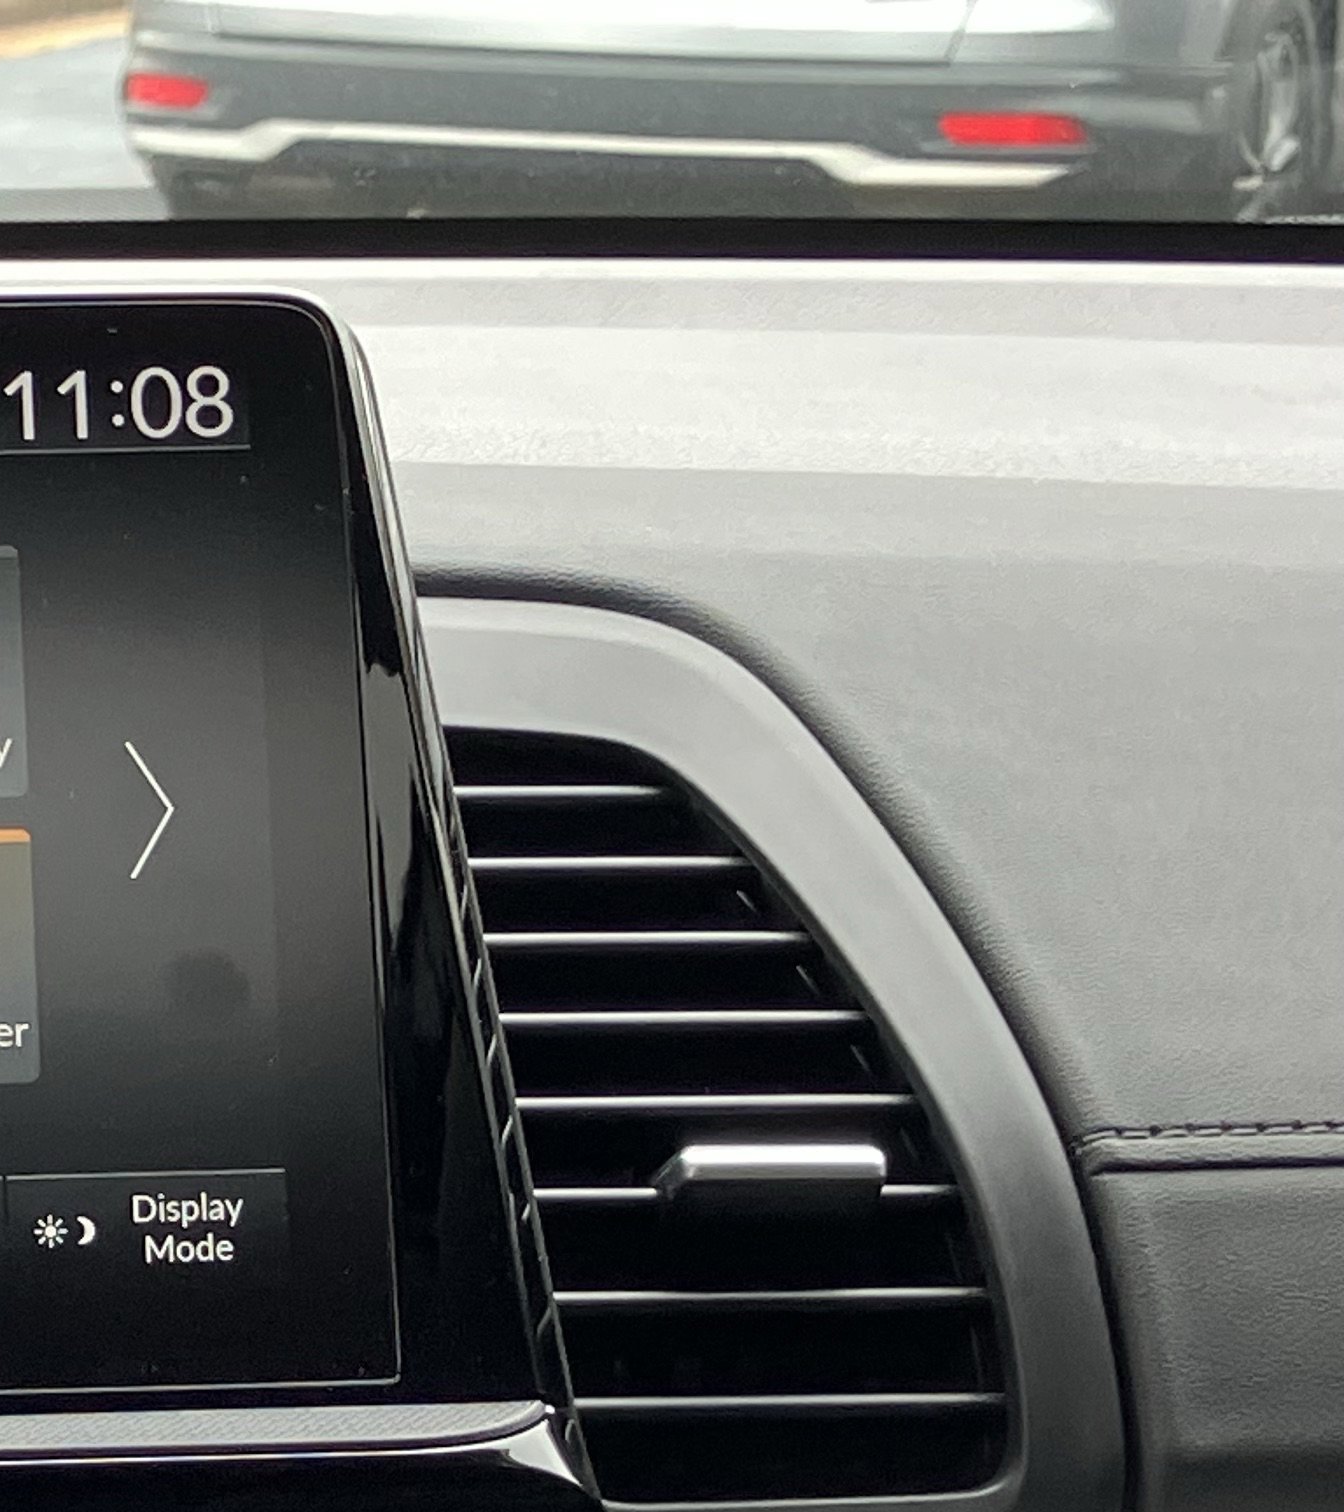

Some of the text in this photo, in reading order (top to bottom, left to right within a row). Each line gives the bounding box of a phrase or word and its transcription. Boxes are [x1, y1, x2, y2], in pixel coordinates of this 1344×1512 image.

[3, 365, 234, 441] 11:08
[132, 1191, 244, 1229] Display
[144, 1232, 234, 1264] Mode
